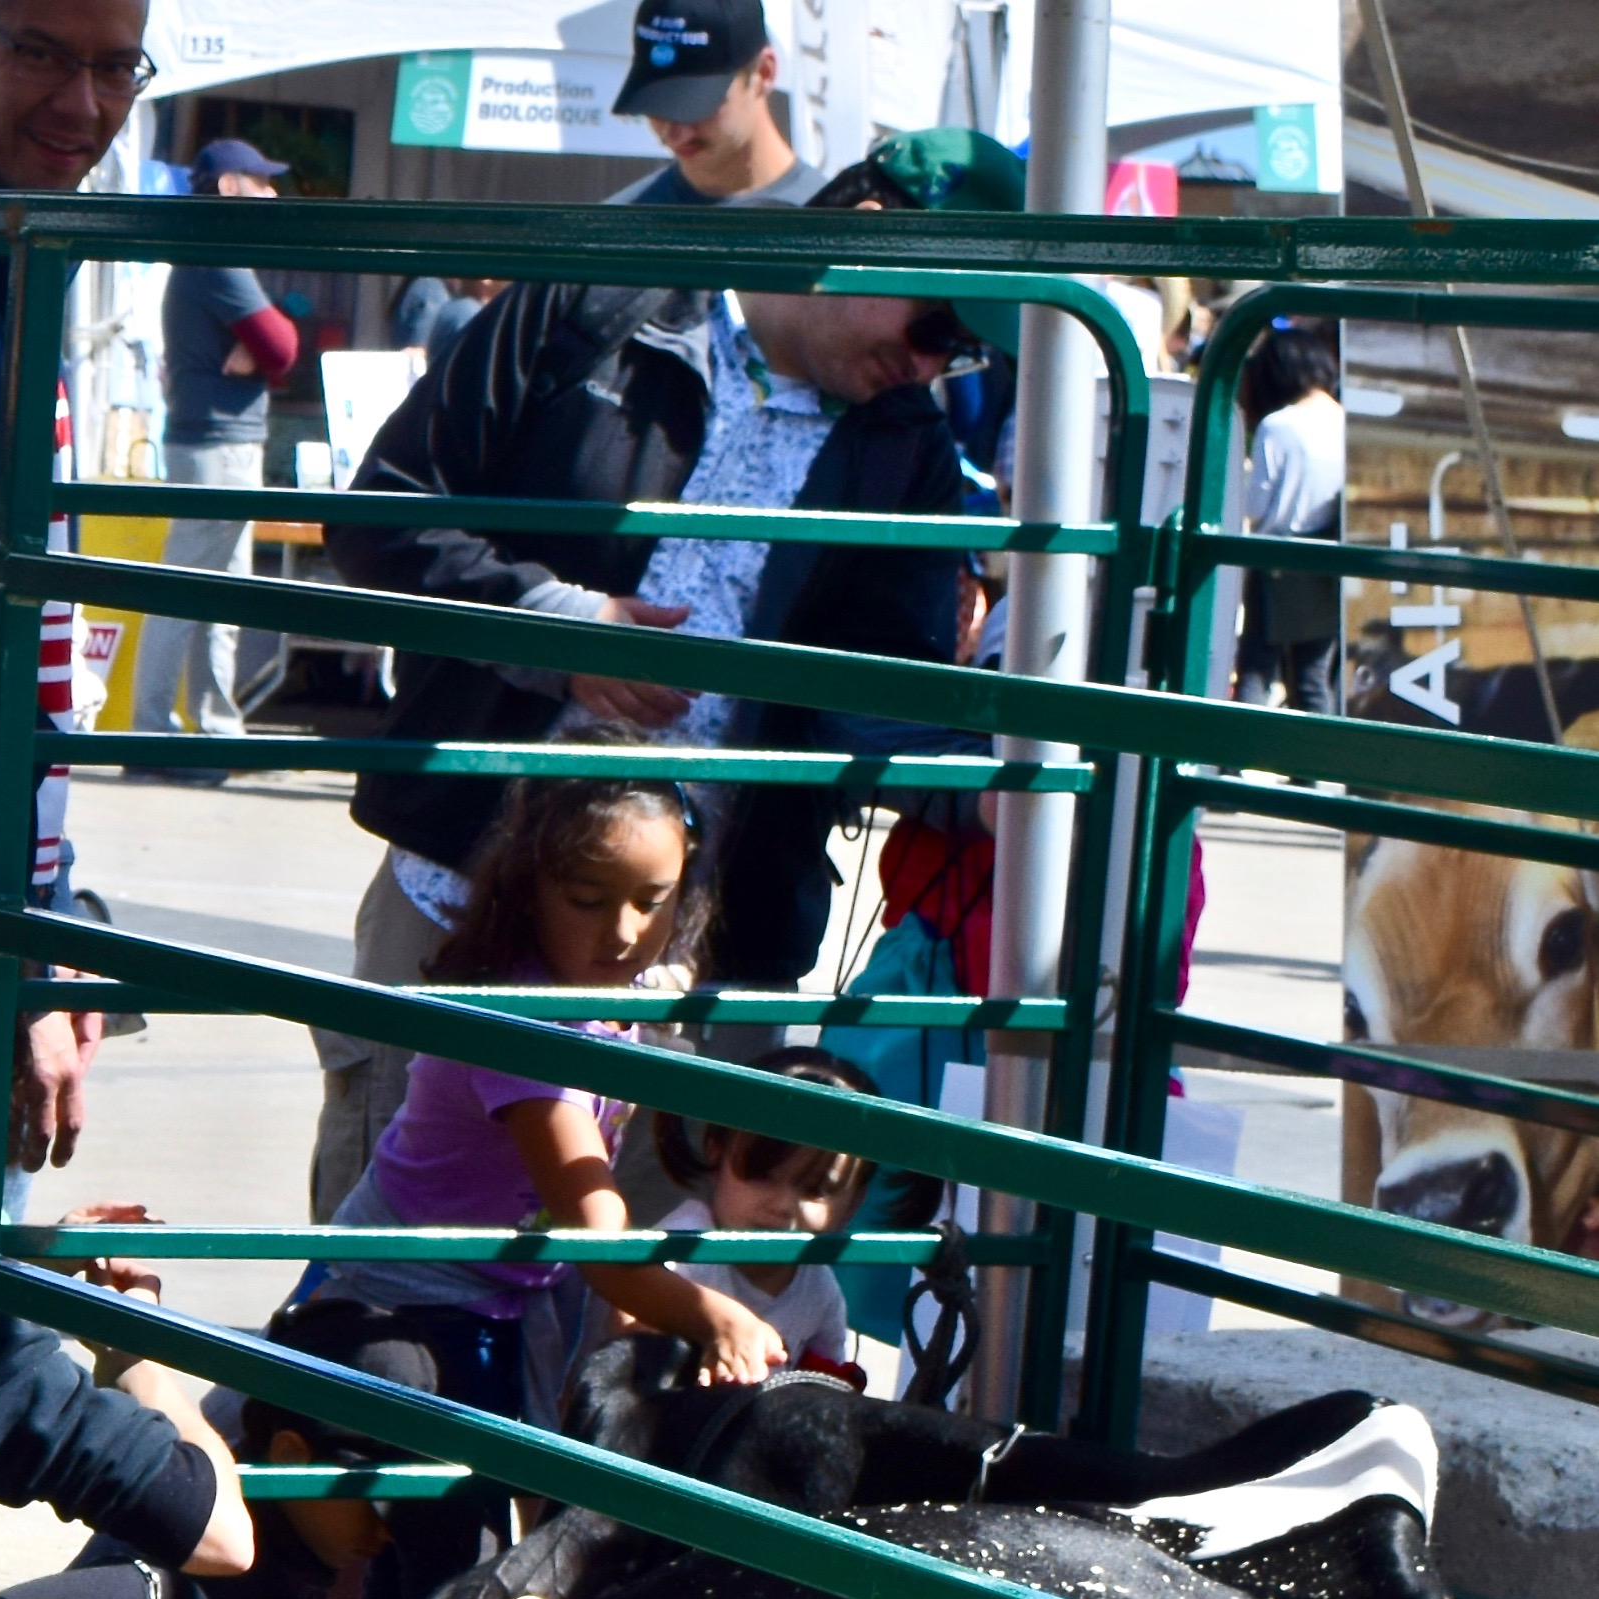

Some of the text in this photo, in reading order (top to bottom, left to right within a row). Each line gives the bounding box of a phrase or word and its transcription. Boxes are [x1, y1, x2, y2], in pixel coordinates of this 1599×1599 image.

[191, 36, 224, 54] 135
[481, 77, 594, 98] Production
[479, 103, 601, 125] BIOLOGIQUE
